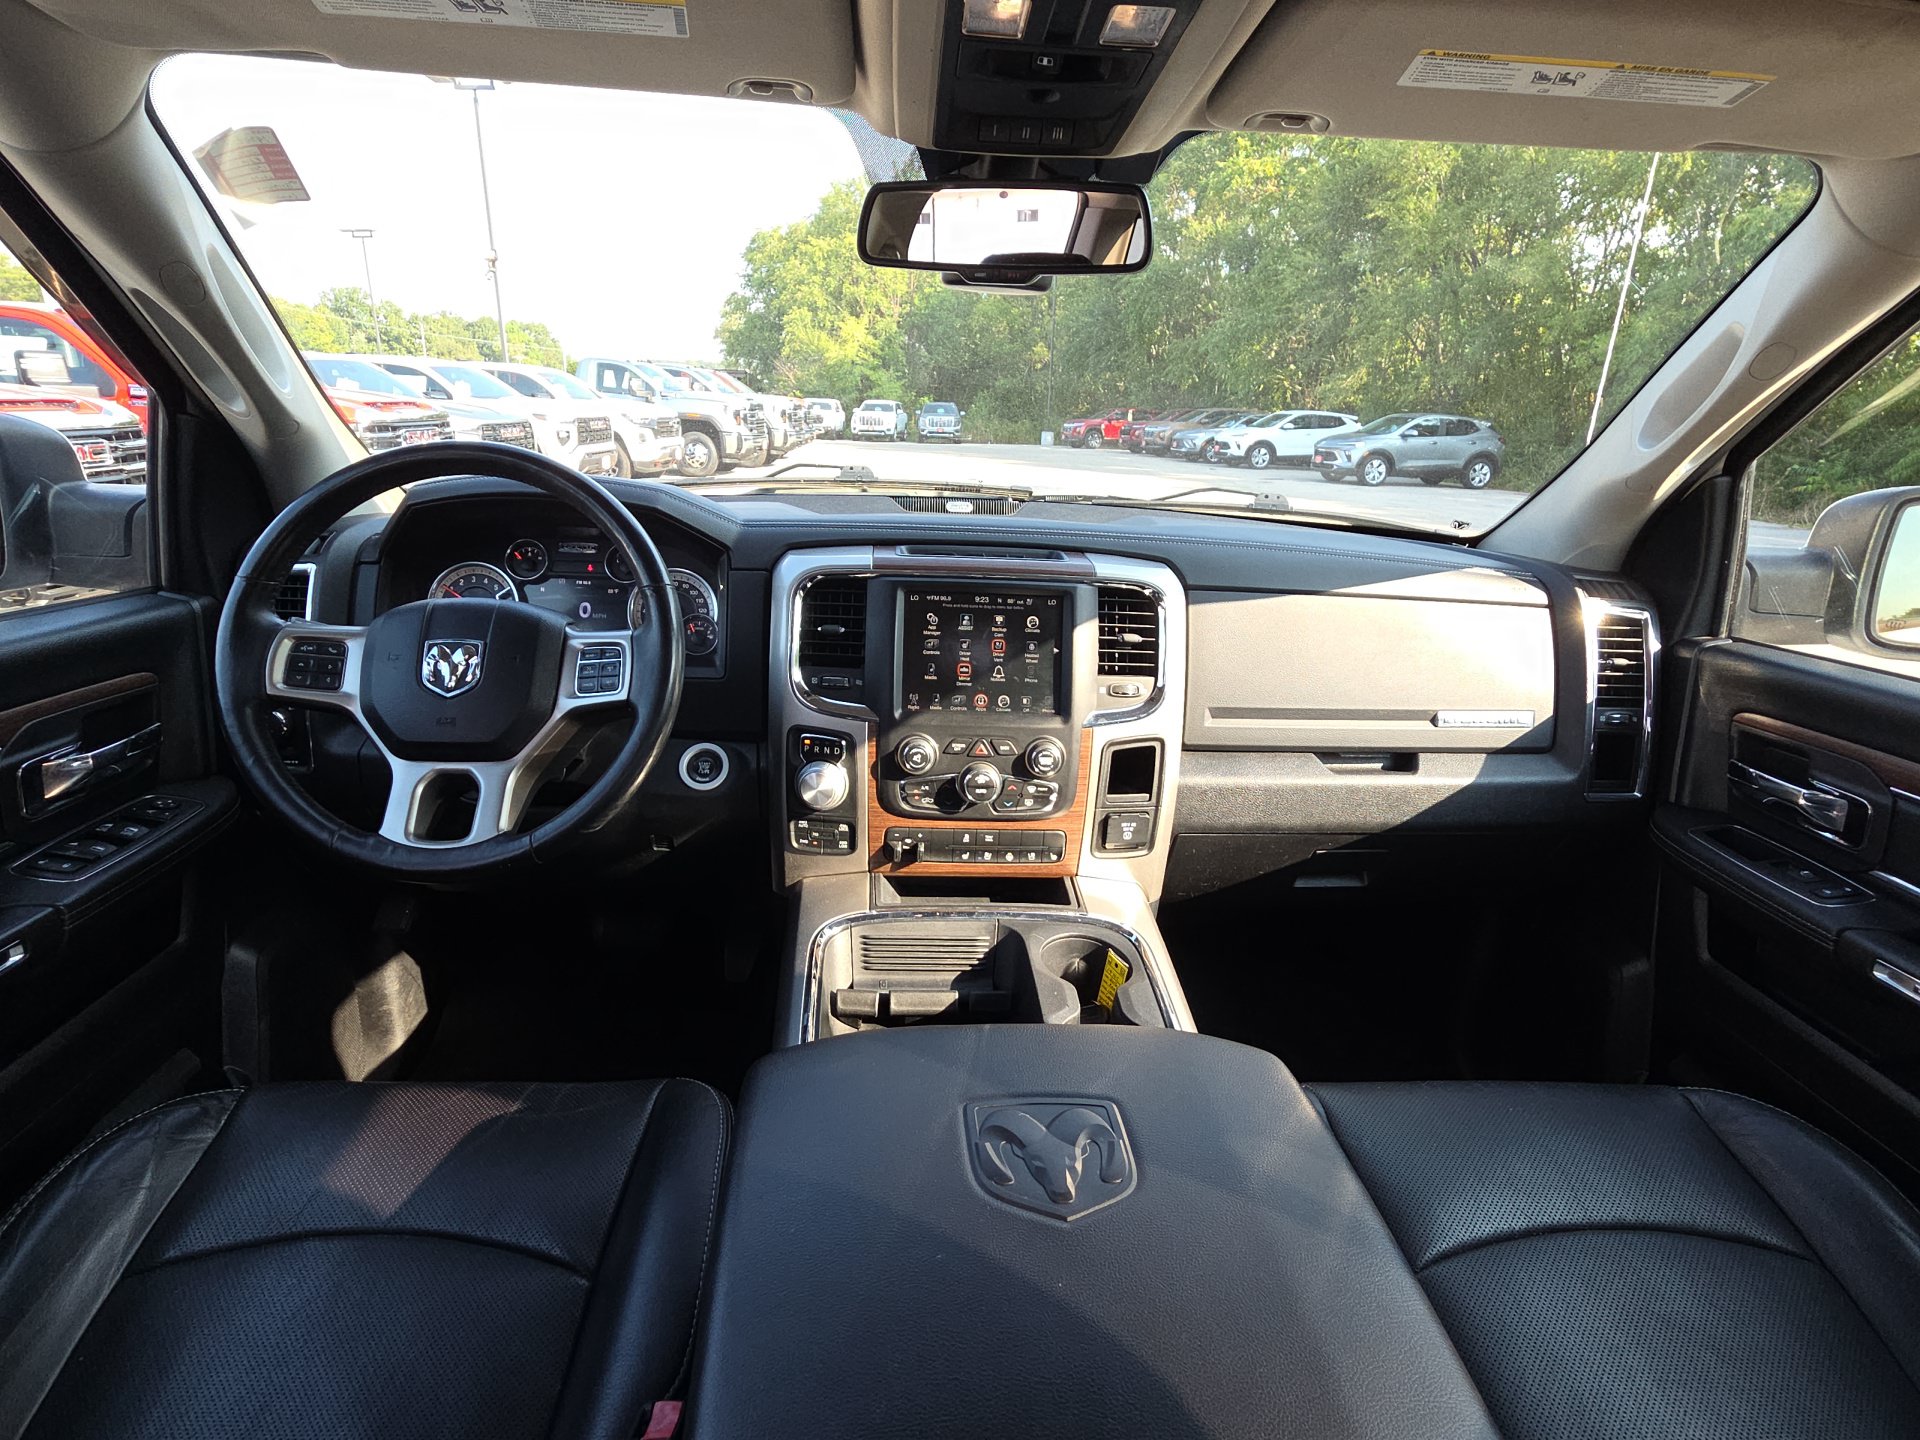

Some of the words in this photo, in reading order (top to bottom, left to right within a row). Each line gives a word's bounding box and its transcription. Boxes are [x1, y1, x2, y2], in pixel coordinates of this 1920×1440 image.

[1442, 52, 1491, 60] WARNING
[1675, 68, 1712, 76] GARDE
[578, 602, 592, 618] 0
